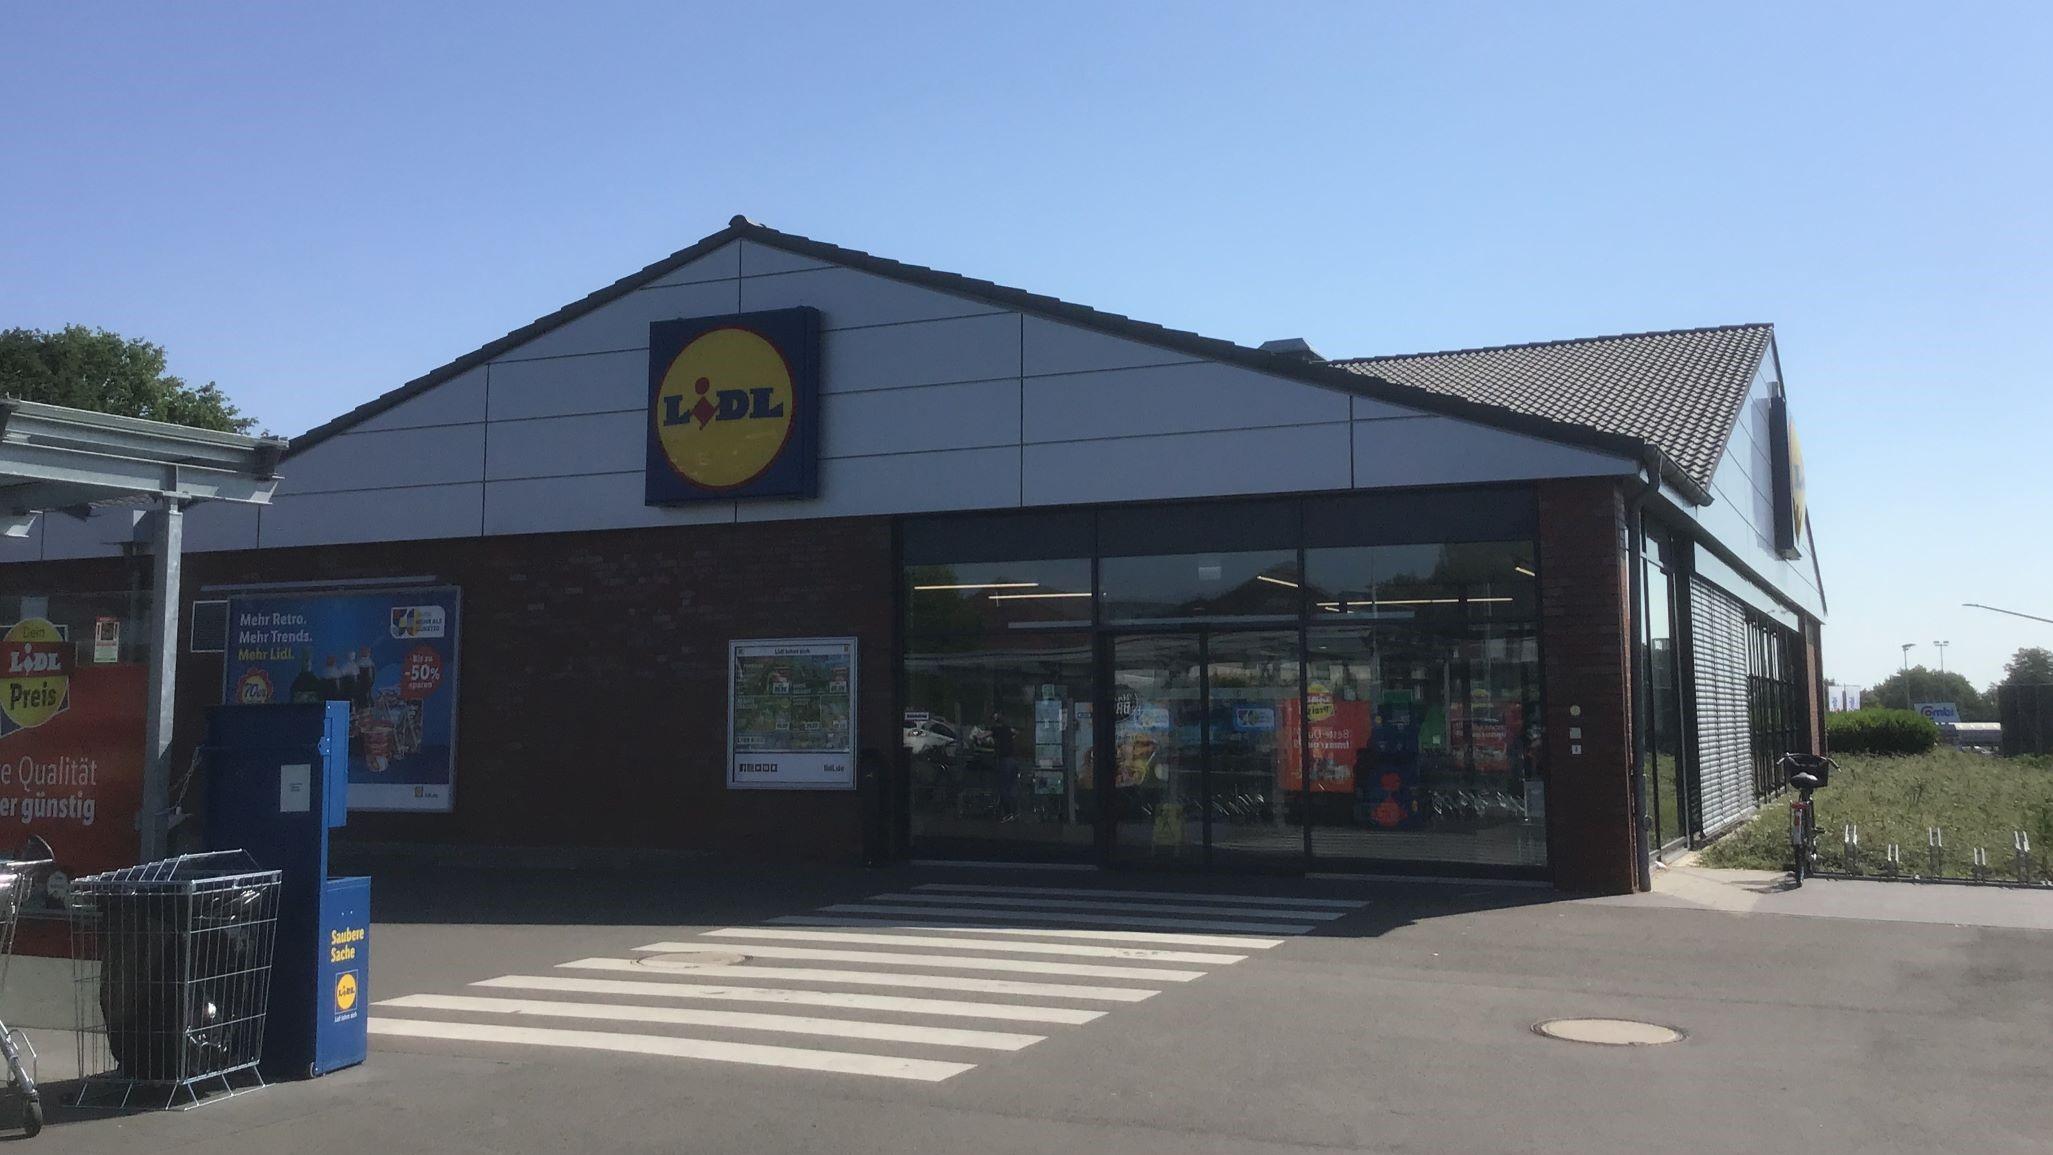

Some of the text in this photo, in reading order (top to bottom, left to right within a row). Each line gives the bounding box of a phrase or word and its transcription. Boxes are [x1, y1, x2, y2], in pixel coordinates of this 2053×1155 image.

[240, 612, 307, 627] Mehr Retro.
[23, 626, 45, 639] Dein
[239, 629, 313, 644] Mehr Trends.
[238, 647, 295, 661] Mehr Lidl.
[404, 663, 440, 681] -50%
[10, 681, 57, 711] Preis
[19, 755, 98, 793] Qualität
[21, 791, 96, 826] günstig
[331, 927, 364, 945] Saubere
[331, 944, 355, 962] Sache
